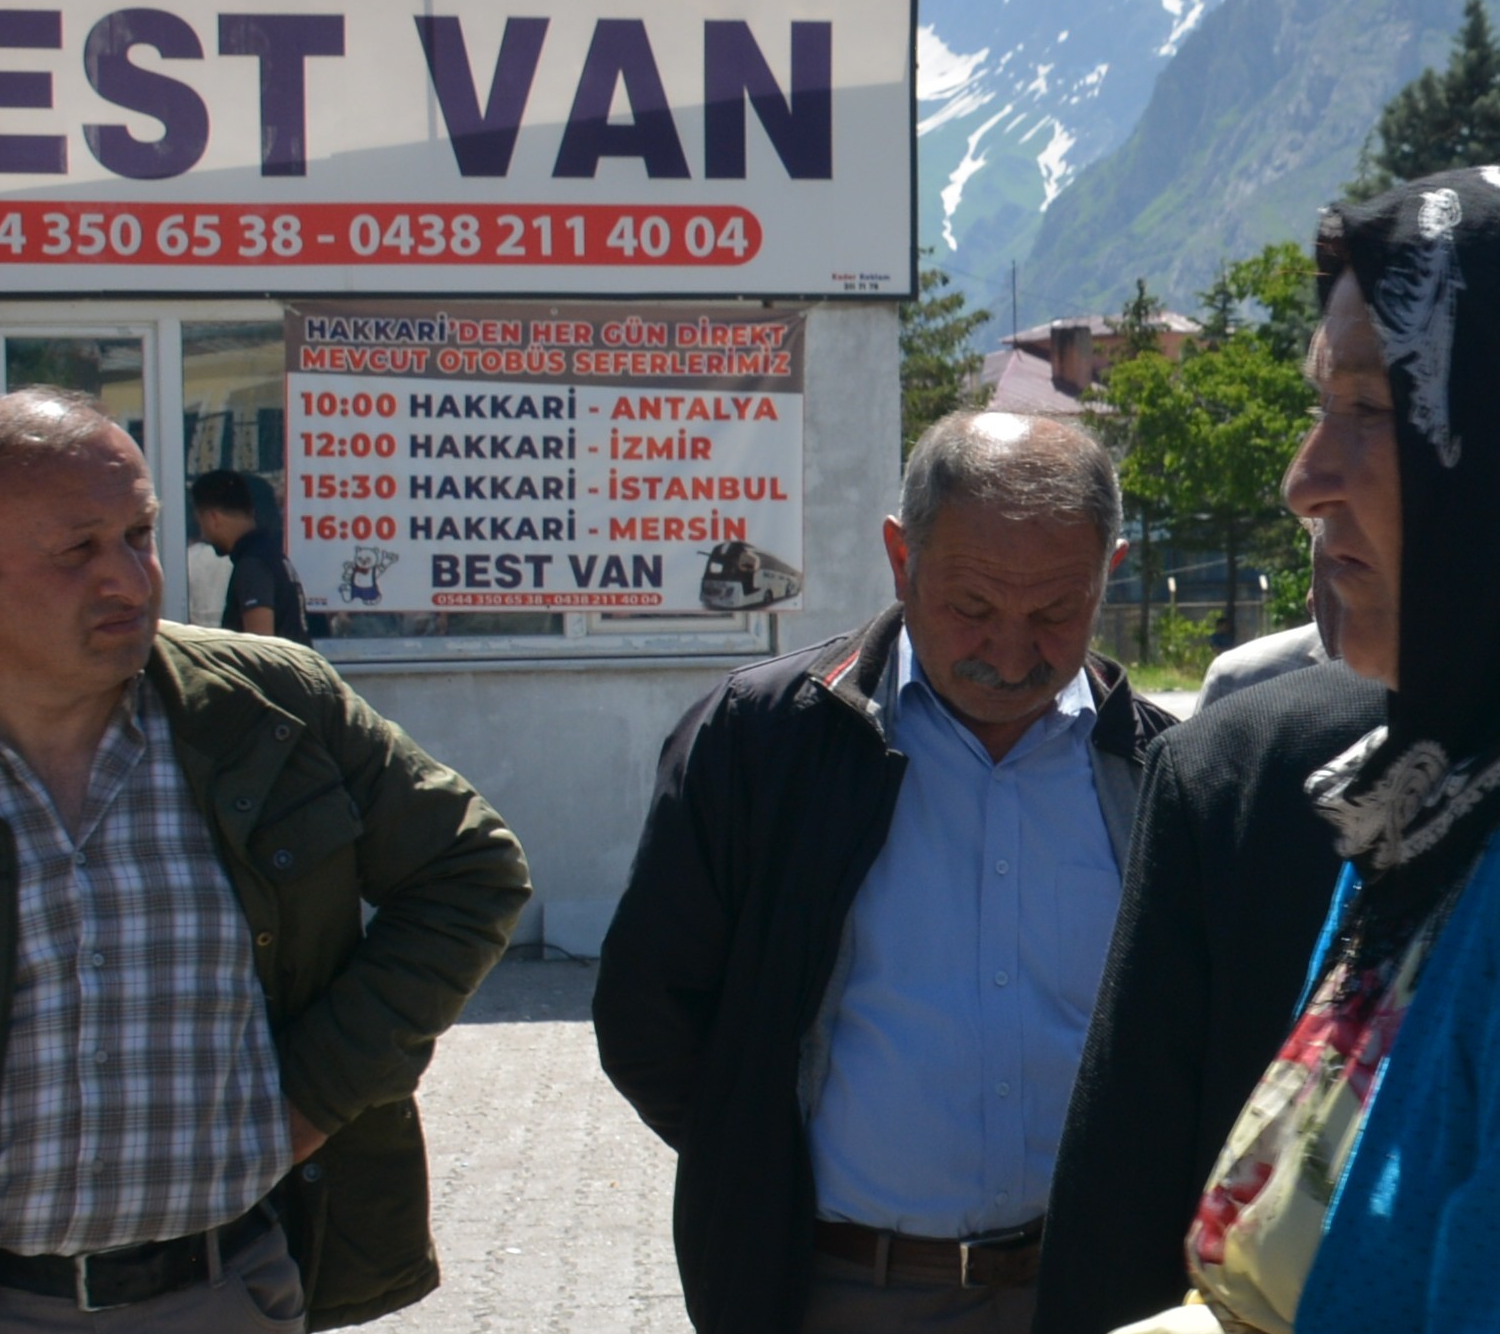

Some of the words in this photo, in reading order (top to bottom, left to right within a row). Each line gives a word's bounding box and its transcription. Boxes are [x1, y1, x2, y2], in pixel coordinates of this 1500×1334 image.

[412, 14, 833, 181] VAN
[41, 212, 143, 255] 350
[156, 213, 222, 256] 65
[237, 214, 304, 256] 38
[348, 214, 481, 257] 0438
[496, 214, 586, 257] 211
[606, 215, 671, 258] 40
[684, 215, 749, 258] 04
[306, 313, 521, 344] HAKKARİ'DEN
[532, 321, 593, 346] HER
[603, 317, 667, 346] GÜN
[676, 316, 787, 347] DİREKT
[301, 347, 430, 372] MEVCUT
[438, 345, 565, 374] OTOBÜS
[573, 346, 791, 375] SEFERLERİMİZ
[300, 392, 397, 418] 10:00
[409, 387, 577, 420] HAKKARİ
[610, 396, 779, 421] ANTALYA
[300, 432, 397, 458] 12:00
[409, 428, 577, 460] HAKKARİ
[609, 428, 713, 460] İZMİR
[300, 474, 398, 500] 15:30
[409, 468, 577, 501] HAKKARİ
[608, 468, 788, 501] İSTANBUL
[300, 515, 397, 541] 16:00
[409, 509, 577, 542] HAKKARİ
[609, 509, 747, 542] MERSİN
[431, 553, 554, 589] BEST
[567, 554, 664, 589] VAN
[437, 594, 473, 605] 0544
[477, 594, 501, 605] 350
[505, 594, 522, 605] 65
[526, 594, 544, 605] 38
[555, 594, 589, 605] 0438
[592, 594, 617, 605] 211
[620, 594, 639, 605] 40
[641, 594, 659, 605] 04
